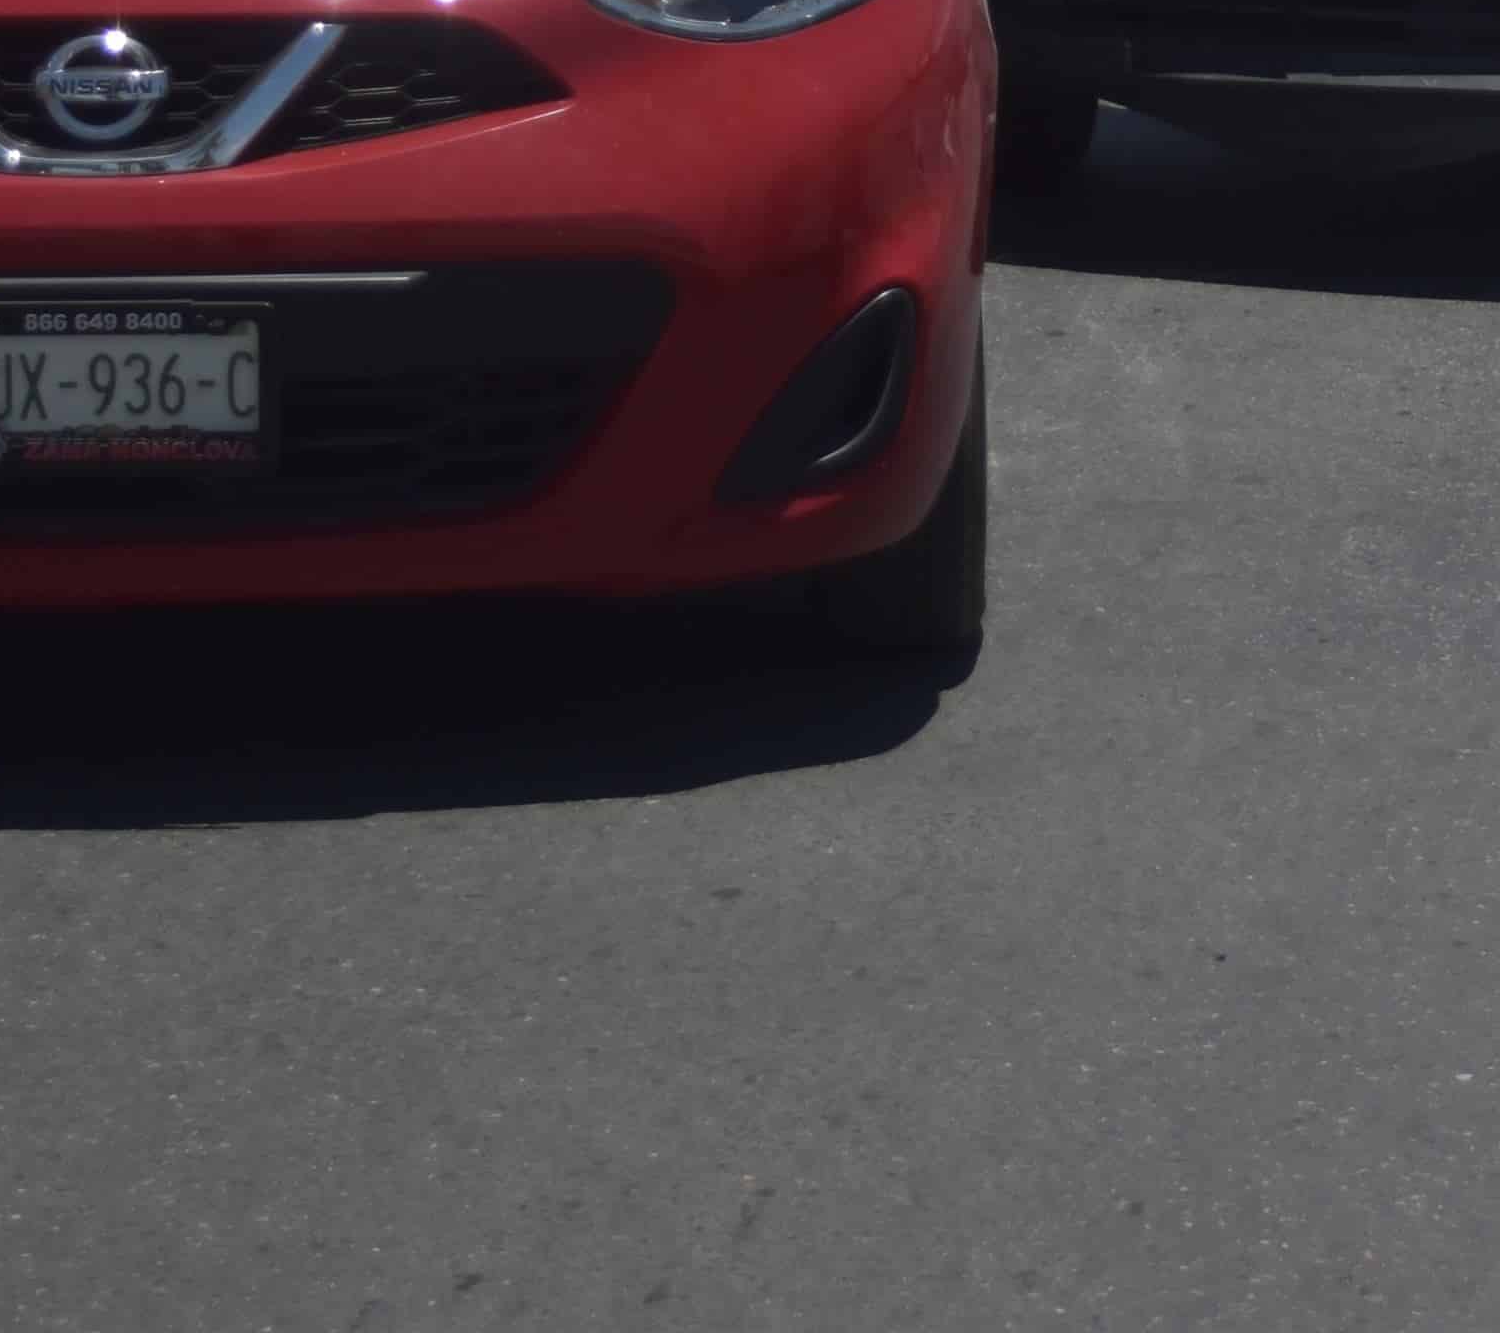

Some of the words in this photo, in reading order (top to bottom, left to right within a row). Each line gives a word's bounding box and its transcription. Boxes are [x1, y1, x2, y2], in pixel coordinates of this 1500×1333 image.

[50, 75, 154, 96] NISSAN
[24, 312, 68, 331] 866
[74, 312, 118, 331] 649
[124, 312, 182, 331] 8400
